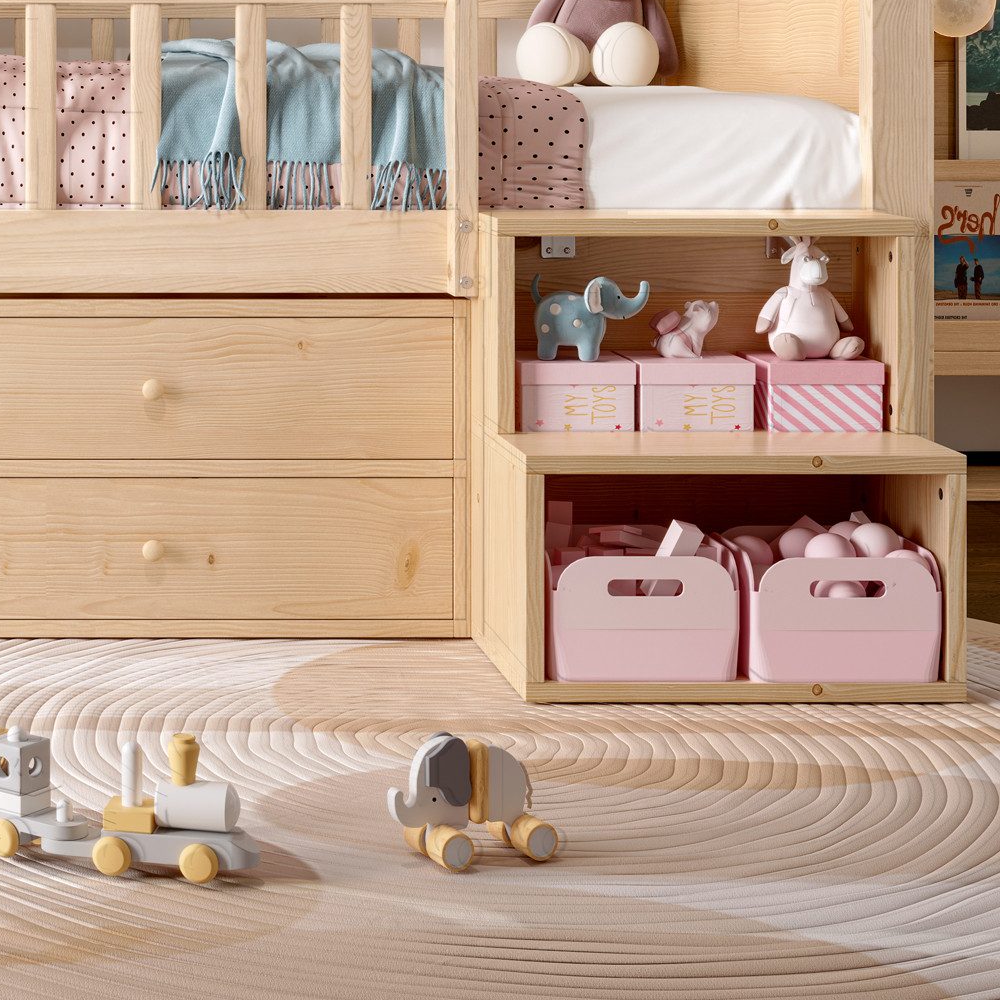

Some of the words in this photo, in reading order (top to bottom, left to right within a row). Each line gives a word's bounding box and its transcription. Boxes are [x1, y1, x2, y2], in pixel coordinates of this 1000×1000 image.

[564, 394, 588, 417] MY
[591, 384, 617, 425] TOYS
[684, 394, 708, 417] MY
[711, 384, 736, 425] TOYS
